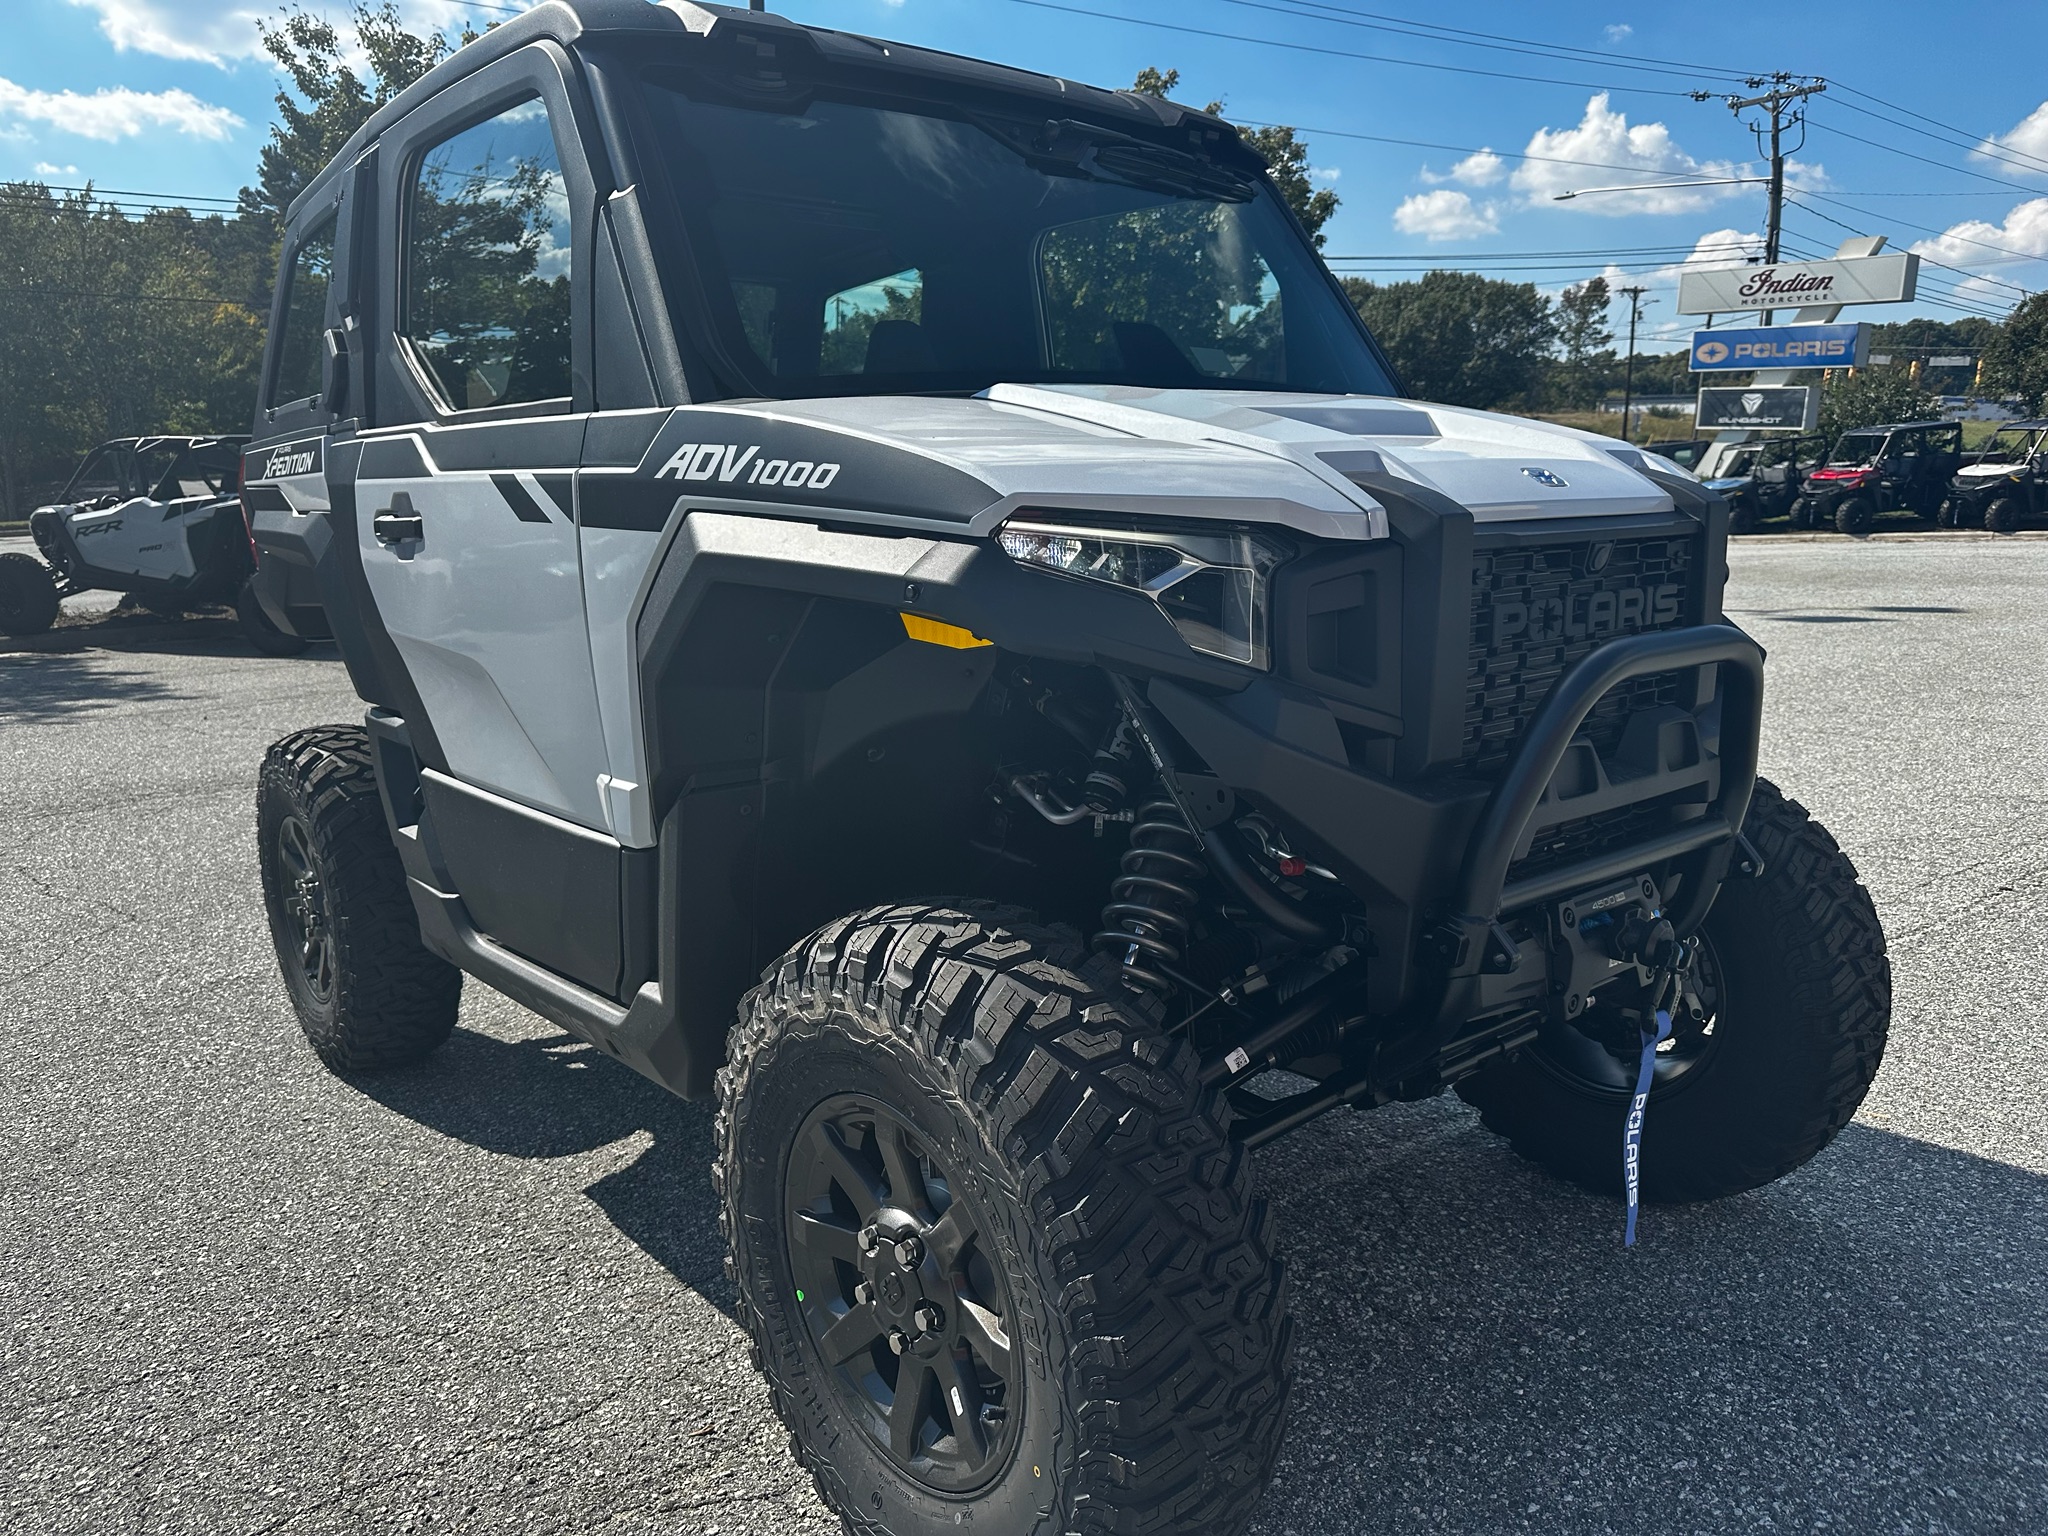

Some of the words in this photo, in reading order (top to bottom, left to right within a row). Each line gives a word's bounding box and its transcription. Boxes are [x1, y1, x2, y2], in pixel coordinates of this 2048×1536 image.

[1739, 268, 1834, 297] Indian
[1741, 294, 1829, 306] MOTORCYCLE
[1734, 340, 1846, 359] POLARIS
[262, 448, 315, 480] XPEDITION
[654, 444, 760, 482] ADV
[747, 458, 841, 489] 1000
[75, 520, 124, 540] RZR
[138, 544, 162, 554] PRO
[1491, 583, 1678, 648] POLARIS
[1592, 895, 1616, 910] 4500
[1627, 1093, 1647, 1208] POLARIS
